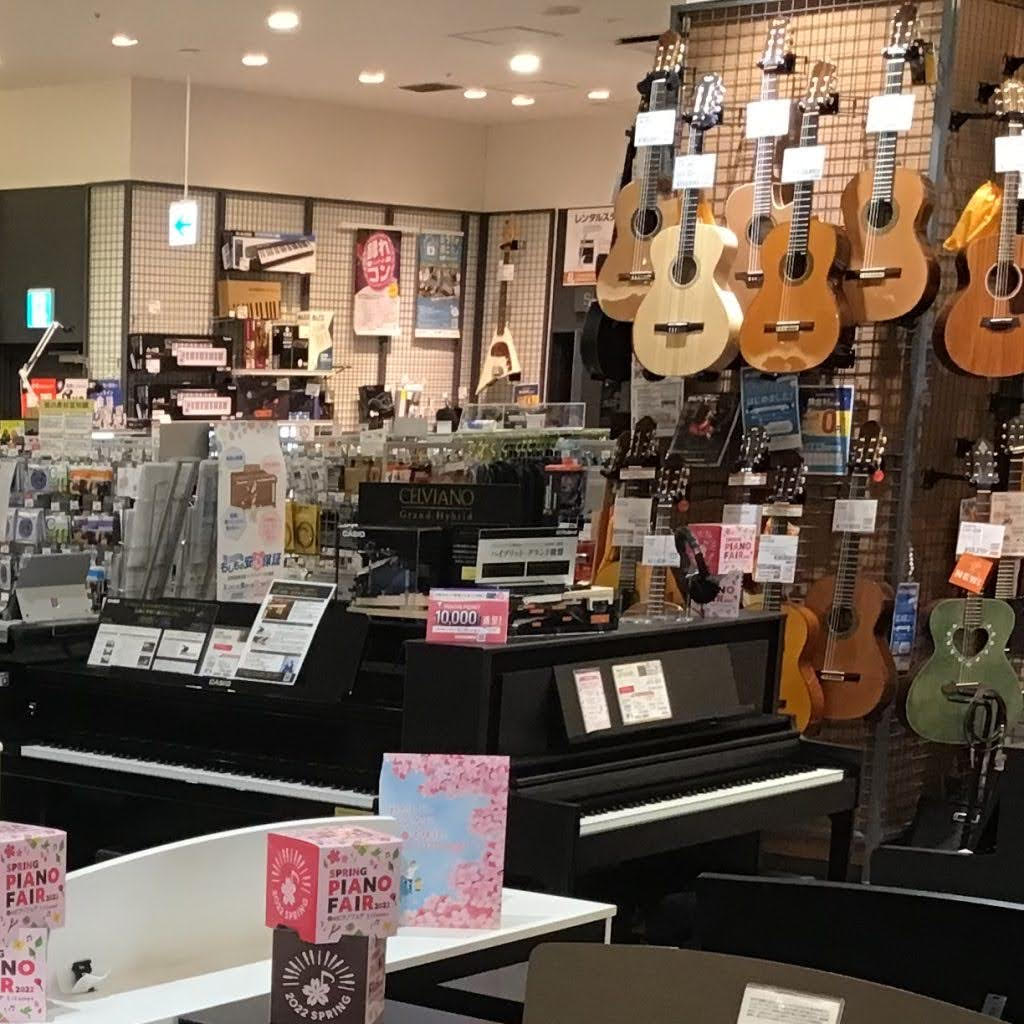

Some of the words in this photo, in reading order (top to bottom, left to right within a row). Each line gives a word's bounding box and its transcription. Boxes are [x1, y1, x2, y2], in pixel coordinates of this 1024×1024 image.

[6, 867, 60, 890] PIANO
[329, 866, 368, 879] SPRING
[328, 874, 393, 896] PIANO
[6, 887, 45, 908] FAIR
[327, 895, 374, 914] FAIR
[284, 992, 308, 1018] 2022
[310, 994, 352, 1022] SPRING
